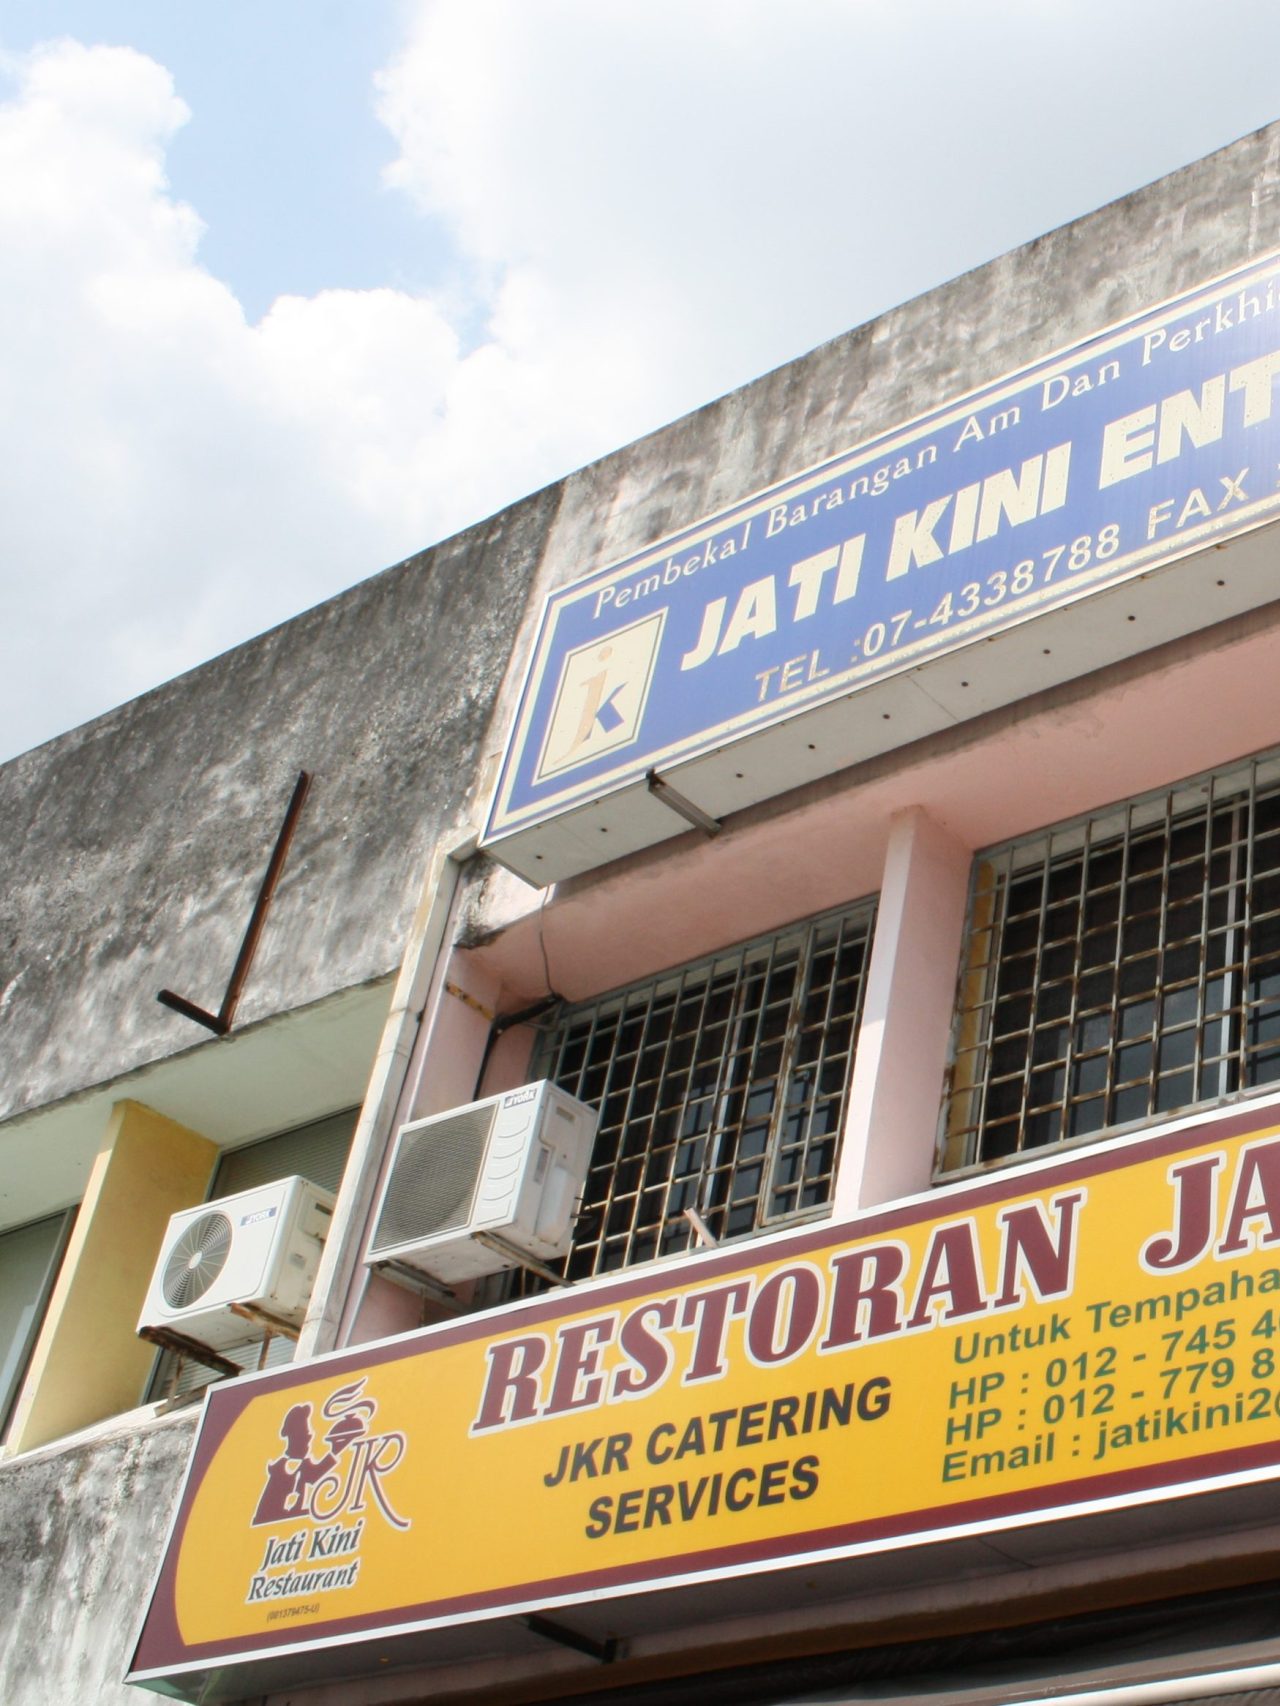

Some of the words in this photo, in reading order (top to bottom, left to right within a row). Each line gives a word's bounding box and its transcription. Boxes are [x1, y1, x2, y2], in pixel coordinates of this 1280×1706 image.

[593, 523, 751, 618] Pembekal
[766, 446, 937, 538] Barangan
[953, 406, 1021, 452] Am
[1041, 358, 1121, 411] Dan
[680, 534, 866, 671] JATI
[886, 441, 1072, 582] KINI
[755, 649, 830, 702] TEL
[1146, 467, 1250, 540] FAX
[471, 1190, 1085, 1434] RESTORAN
[954, 1315, 1071, 1364] Untuk
[945, 1408, 1001, 1446] HP
[1043, 1383, 1114, 1425] 012
[1160, 1358, 1235, 1400] 779
[949, 1372, 1004, 1409] HP
[1046, 1346, 1116, 1388] 012
[1162, 1319, 1236, 1362] 745
[543, 1430, 633, 1487] JKR
[646, 1375, 892, 1465] CATERING
[942, 1432, 1055, 1483] Email
[584, 1455, 820, 1539] SERVICES
[247, 1563, 358, 1601] Restaurant
[259, 1535, 303, 1571] Jati
[308, 1520, 363, 1561] Kini
